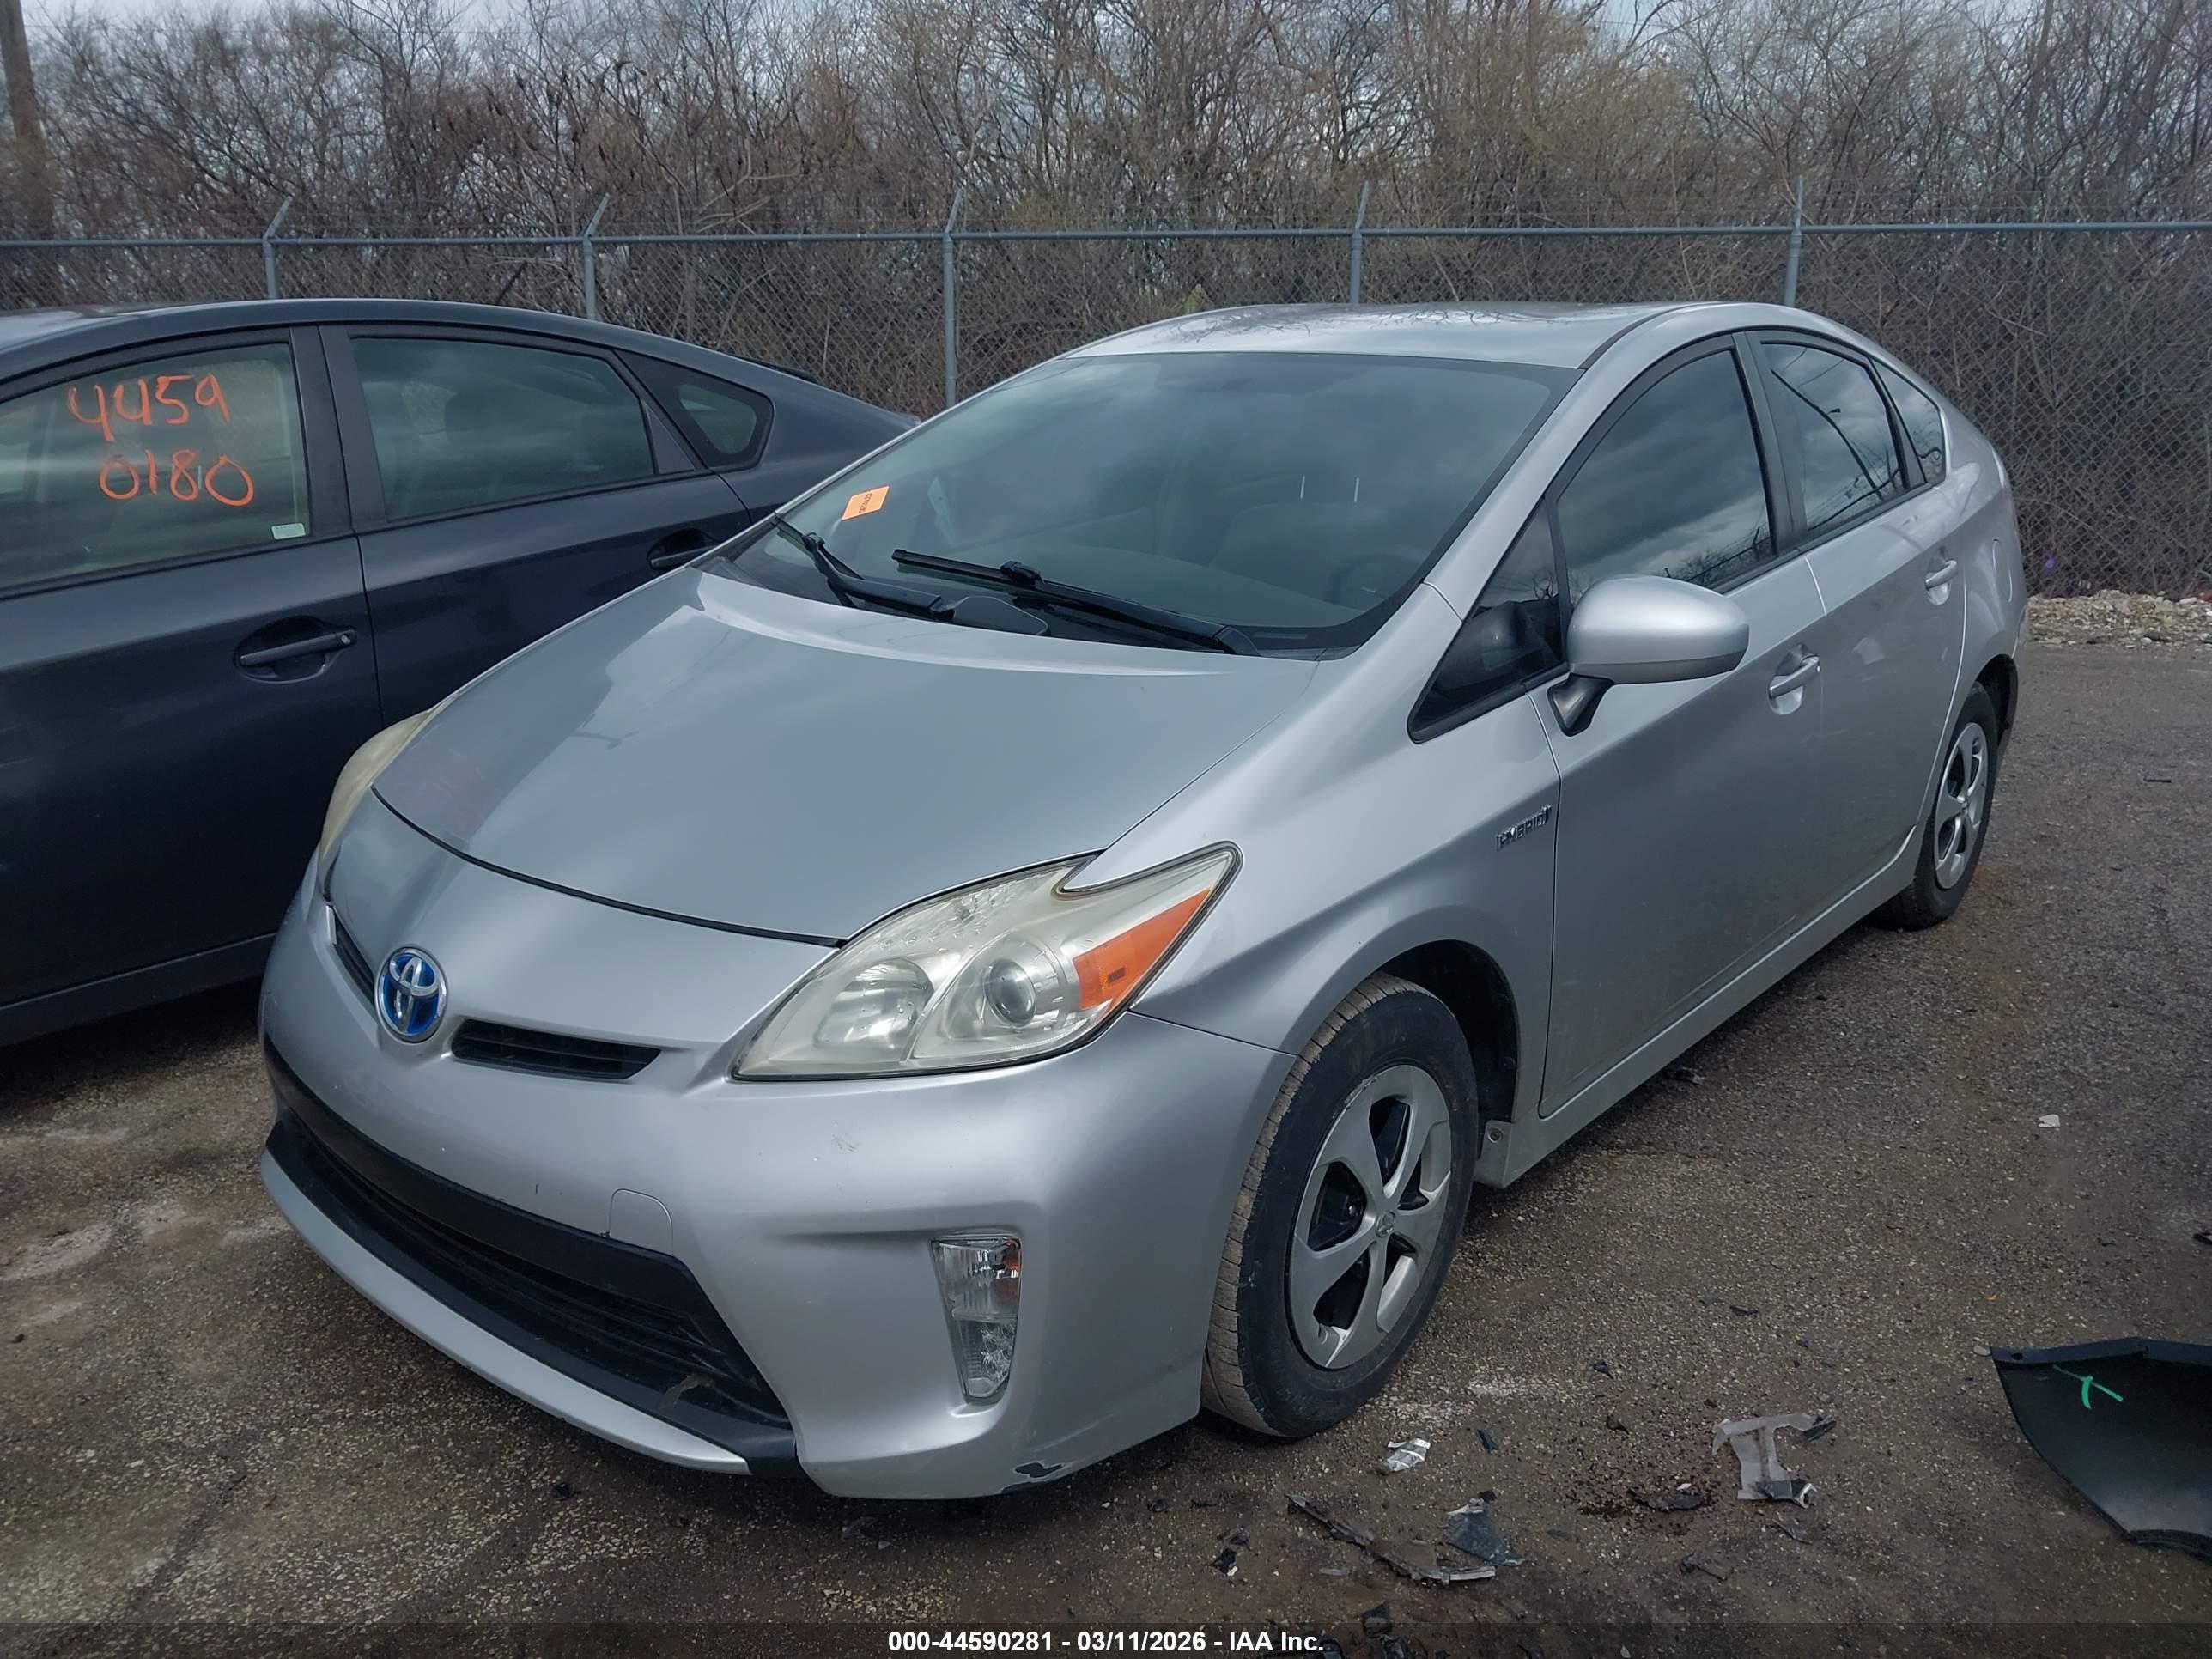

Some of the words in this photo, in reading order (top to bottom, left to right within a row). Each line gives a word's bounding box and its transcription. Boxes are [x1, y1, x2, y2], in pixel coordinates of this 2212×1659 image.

[68, 374, 231, 442] 4459
[99, 449, 255, 507] 0180
[1495, 805, 1552, 851] HYBRID
